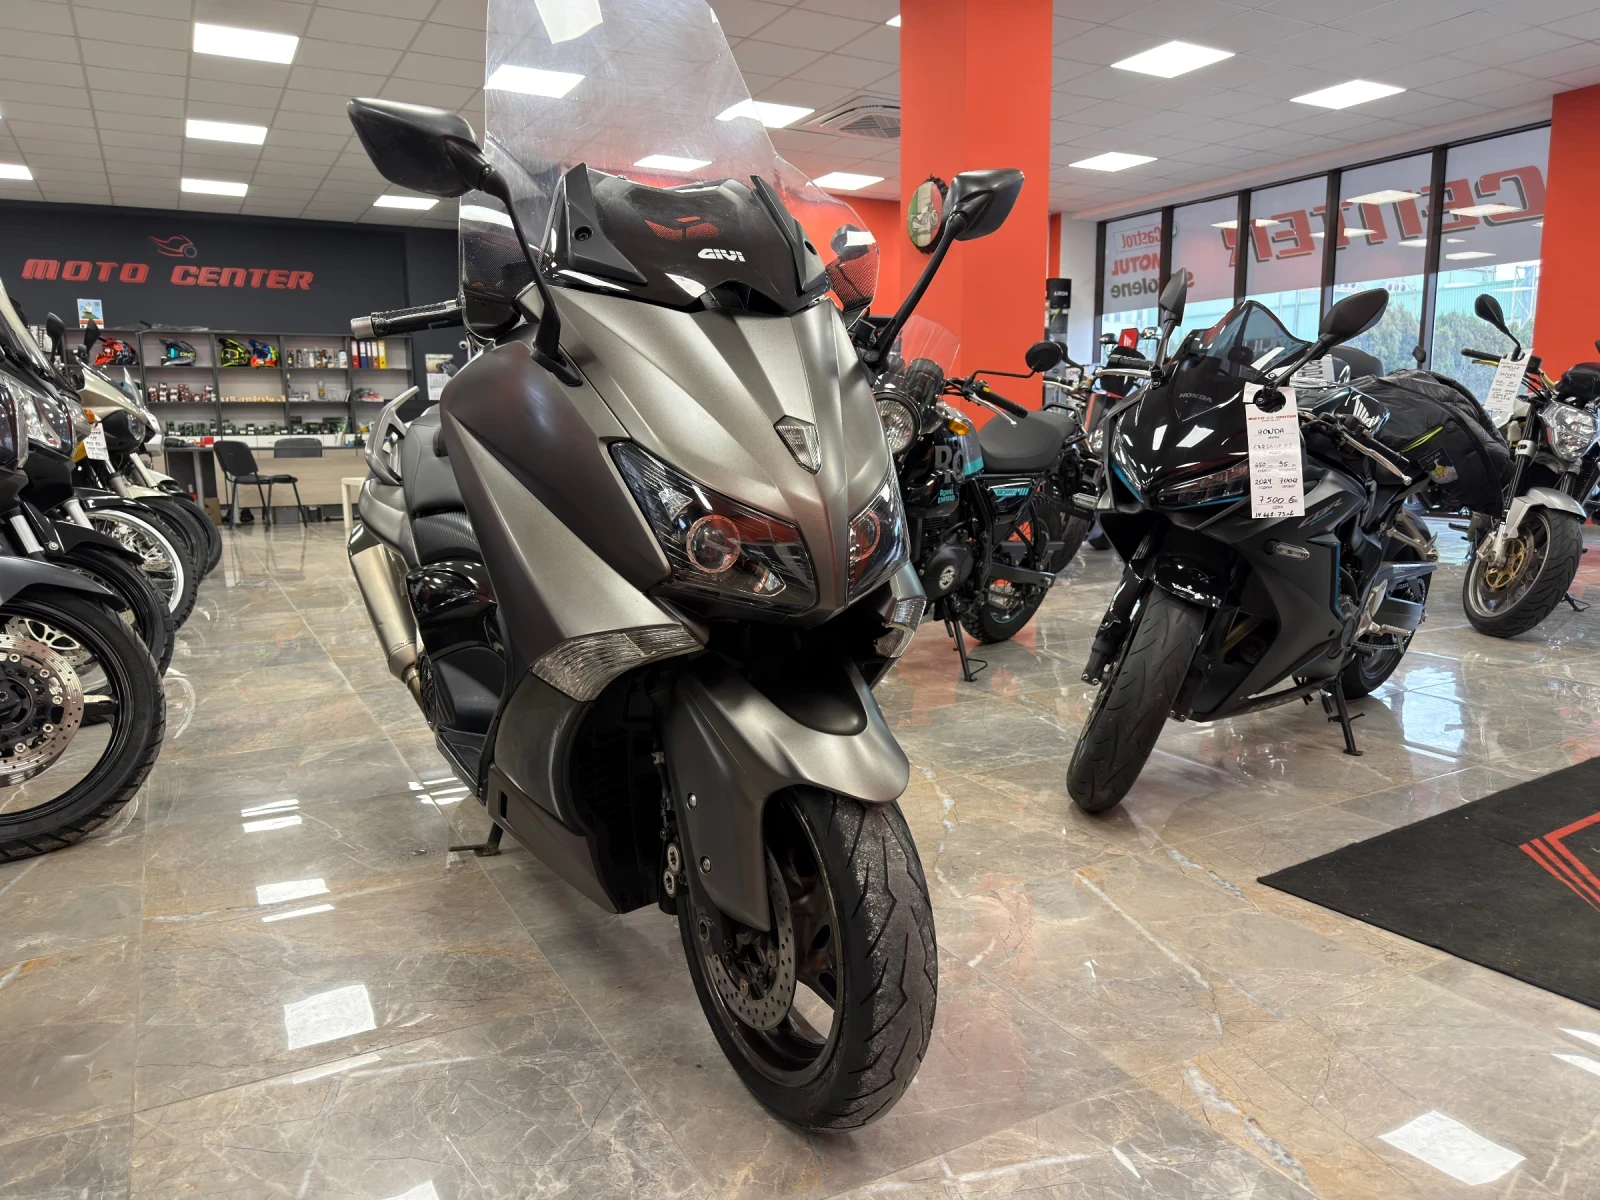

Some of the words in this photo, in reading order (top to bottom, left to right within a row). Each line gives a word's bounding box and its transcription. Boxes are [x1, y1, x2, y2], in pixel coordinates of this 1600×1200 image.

[697, 248, 746, 262] GIVI
[21, 258, 150, 283] MOTO
[170, 265, 314, 290] CENTER
[1178, 392, 1213, 404] HONDA
